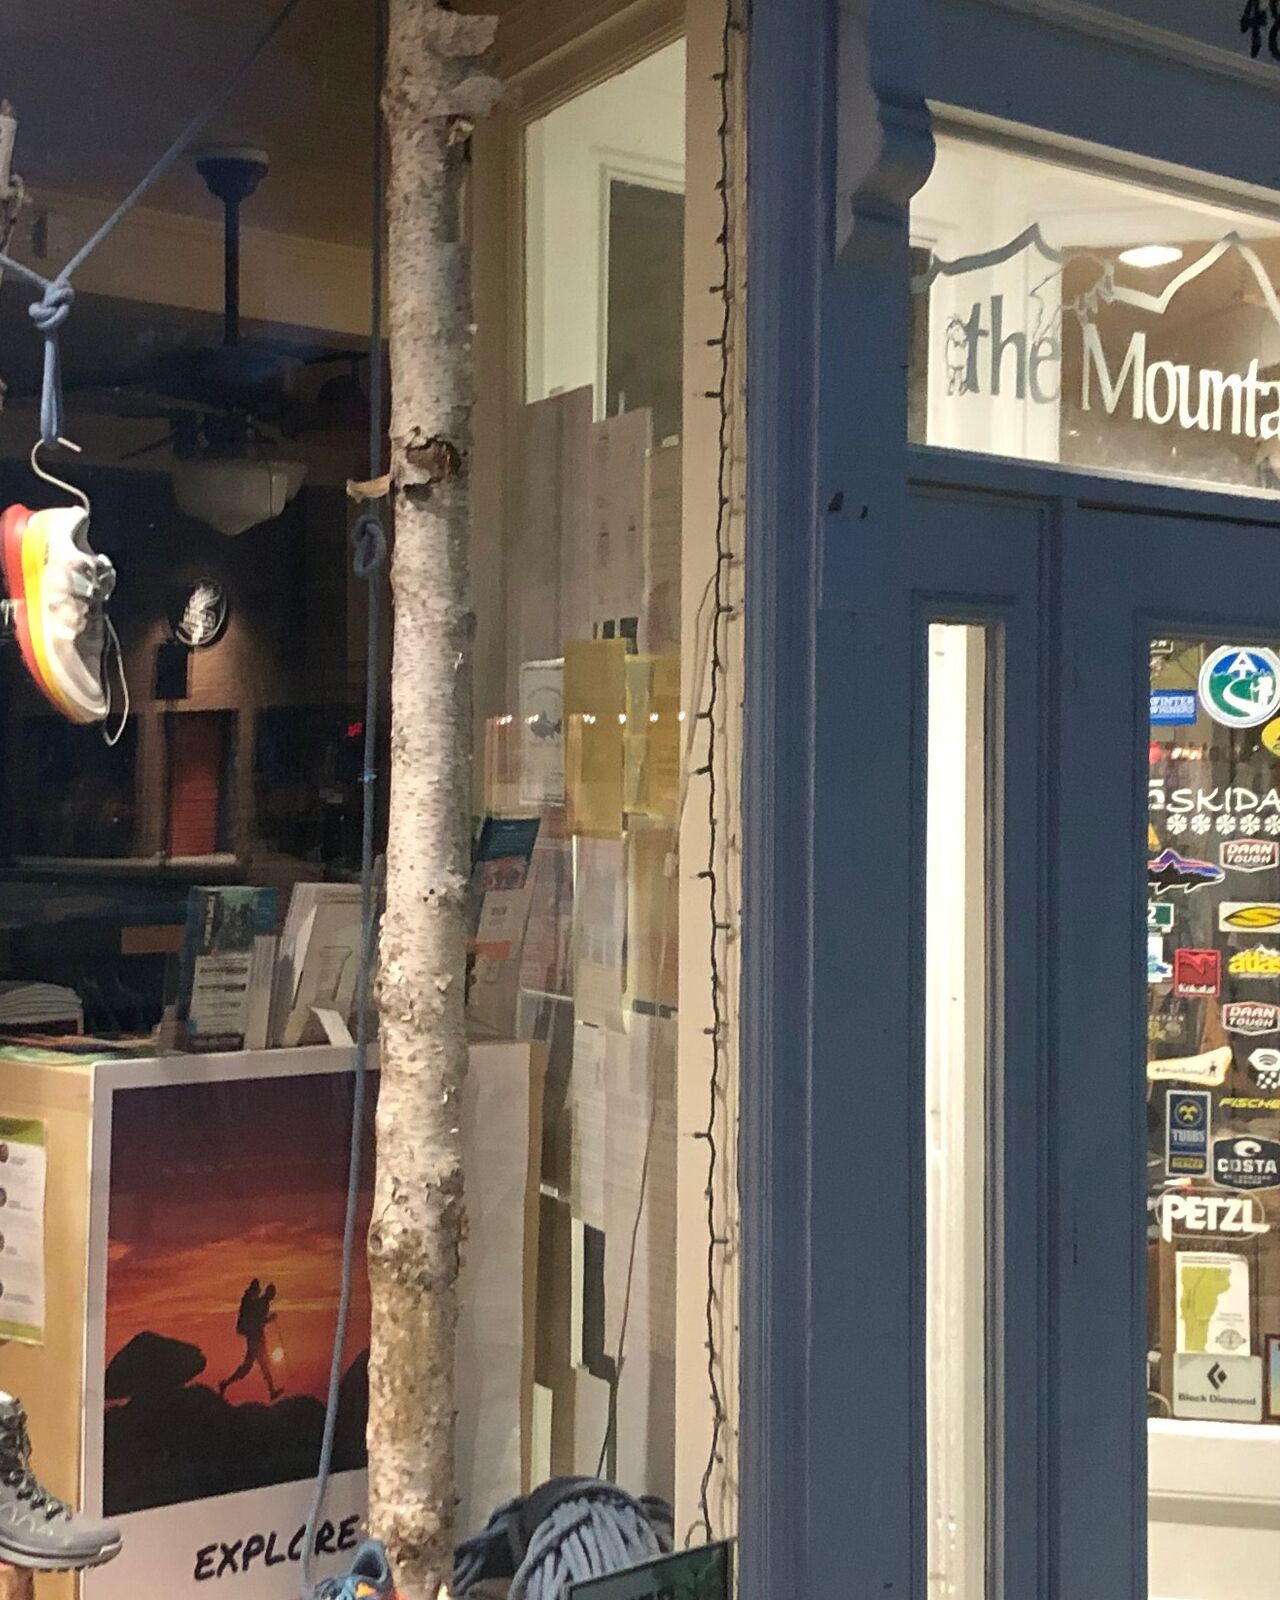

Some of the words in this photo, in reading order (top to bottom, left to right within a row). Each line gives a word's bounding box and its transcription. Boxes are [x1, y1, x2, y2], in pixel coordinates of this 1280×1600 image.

[965, 294, 1062, 405] the
[1227, 855, 1272, 864] TOUGH
[1229, 1017, 1274, 1028] TOUGH
[1217, 1157, 1278, 1174] COSTA
[1161, 1193, 1271, 1243] PETZL
[1177, 1392, 1208, 1403] Black
[1209, 1394, 1257, 1406] Diamond
